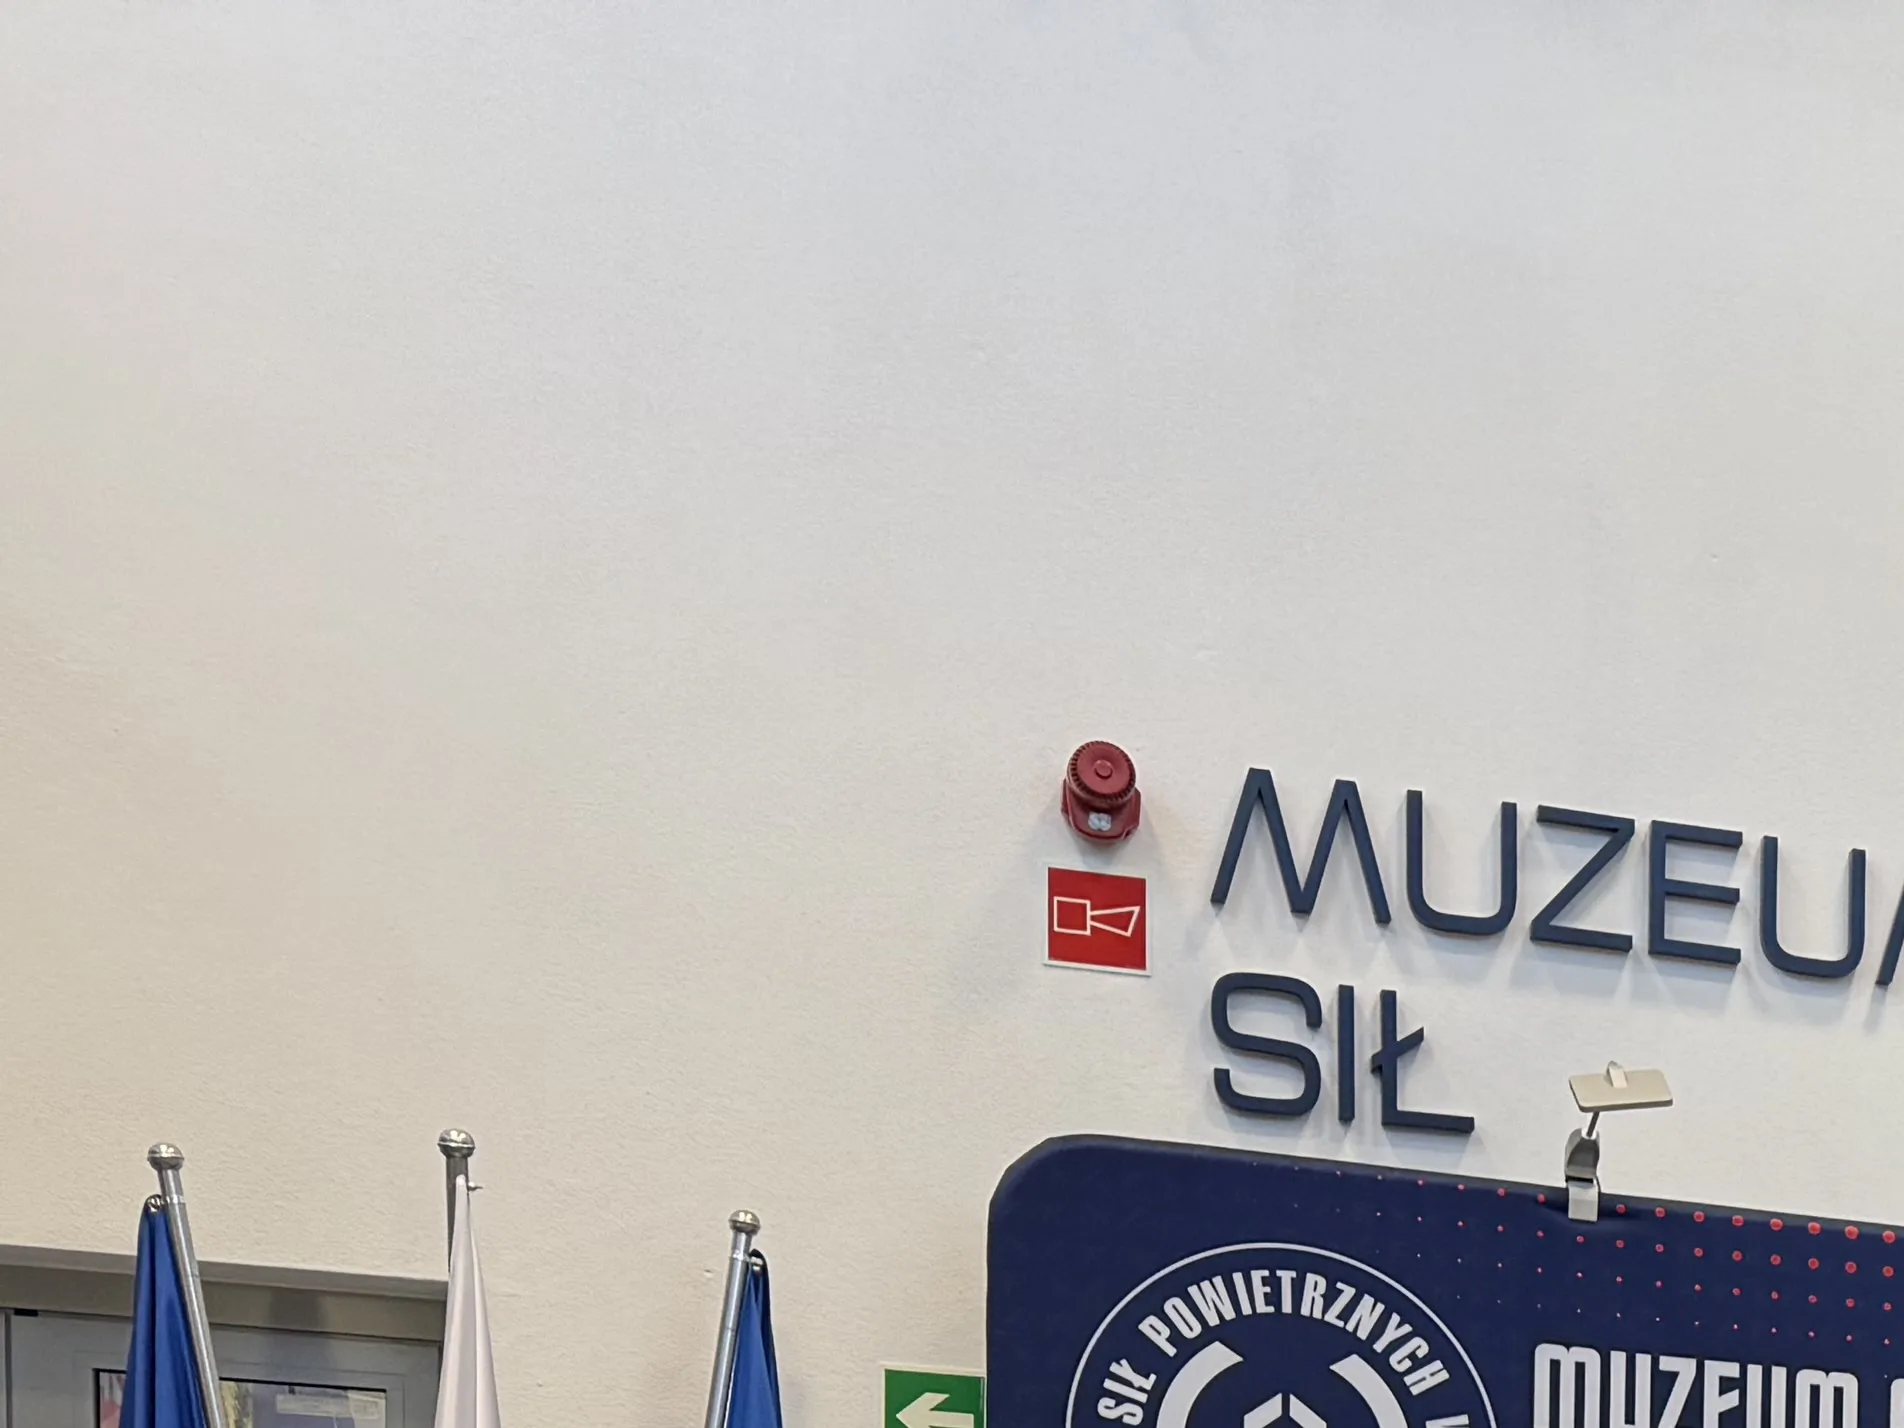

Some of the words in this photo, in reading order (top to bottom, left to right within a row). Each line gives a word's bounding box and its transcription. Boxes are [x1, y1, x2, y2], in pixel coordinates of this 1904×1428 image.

[1210, 971, 1475, 1134] SIŁ
[1097, 1358, 1157, 1426] SIŁ
[1138, 1269, 1450, 1396] POWIETRZNYCH
